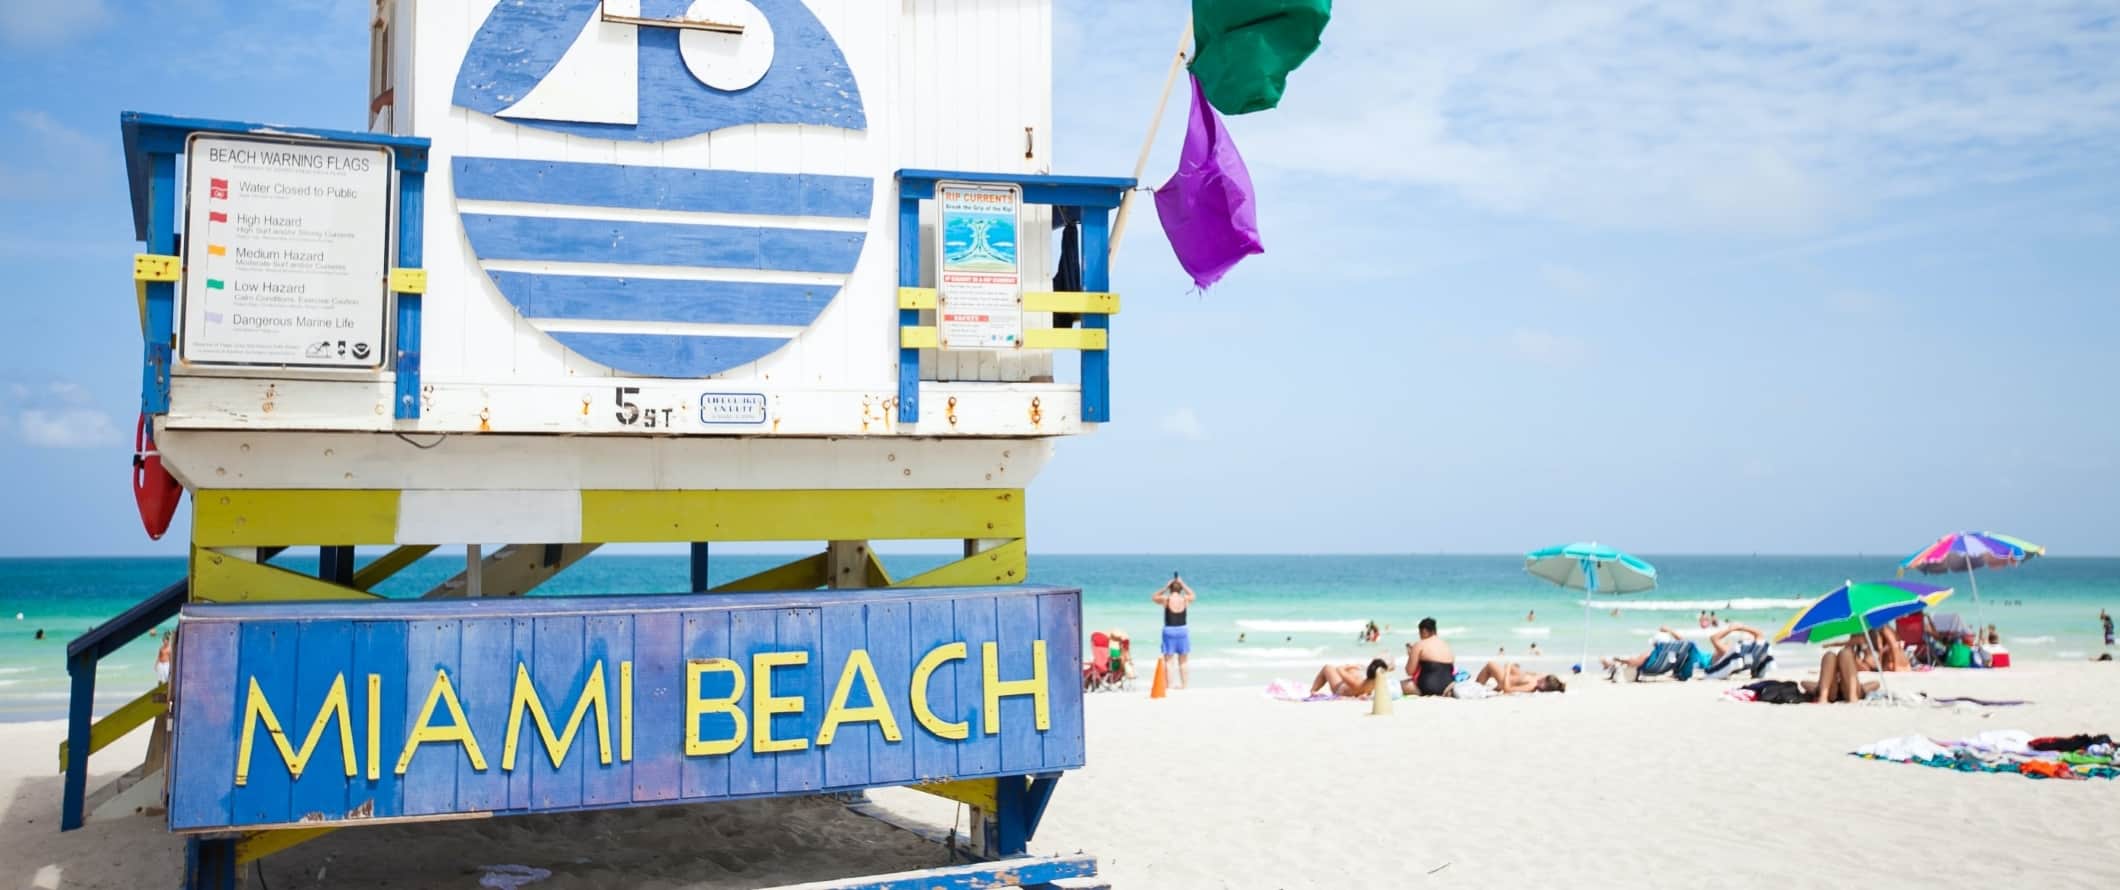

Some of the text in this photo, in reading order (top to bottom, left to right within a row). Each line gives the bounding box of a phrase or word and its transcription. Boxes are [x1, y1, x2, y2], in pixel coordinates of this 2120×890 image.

[209, 147, 256, 164] BEACH
[260, 151, 323, 169] WARNING
[326, 156, 370, 172] FLAGS
[240, 181, 358, 199] Water Closed to Public
[946, 192, 1014, 204] RIP CURRENTS
[236, 213, 302, 228] High Hazard
[236, 247, 324, 262] Medium Hazard
[234, 279, 305, 294] Low Hazard
[233, 313, 355, 329] Dangerous Marine Life
[615, 386, 640, 425] 5
[233, 638, 1052, 787] MIAMI BEACH
